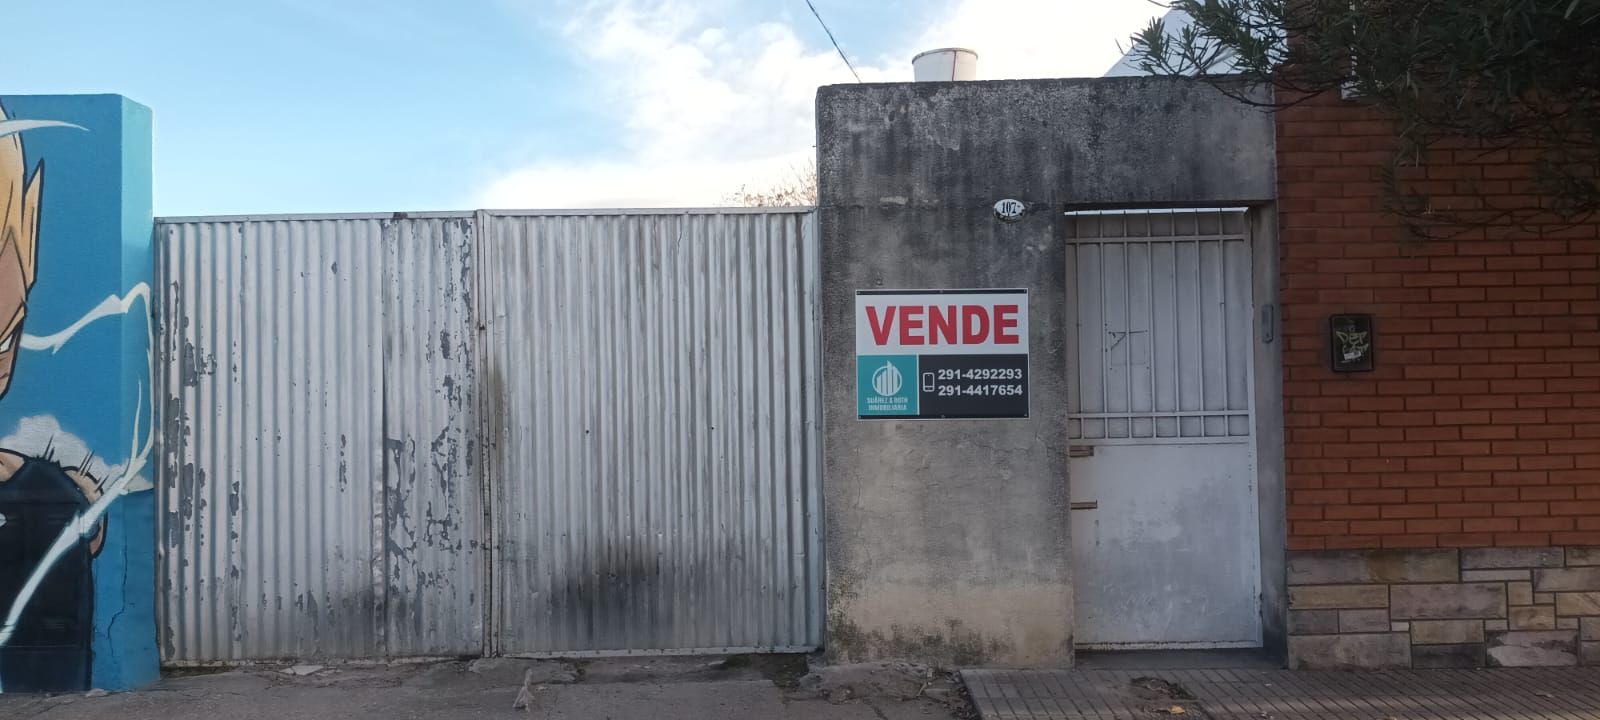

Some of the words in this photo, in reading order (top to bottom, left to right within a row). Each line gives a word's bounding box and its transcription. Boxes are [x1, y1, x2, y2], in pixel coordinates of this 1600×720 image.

[865, 304, 1019, 345] VENDE
[938, 368, 1022, 380] 291-4292293
[938, 385, 1023, 396] 291-4417654
